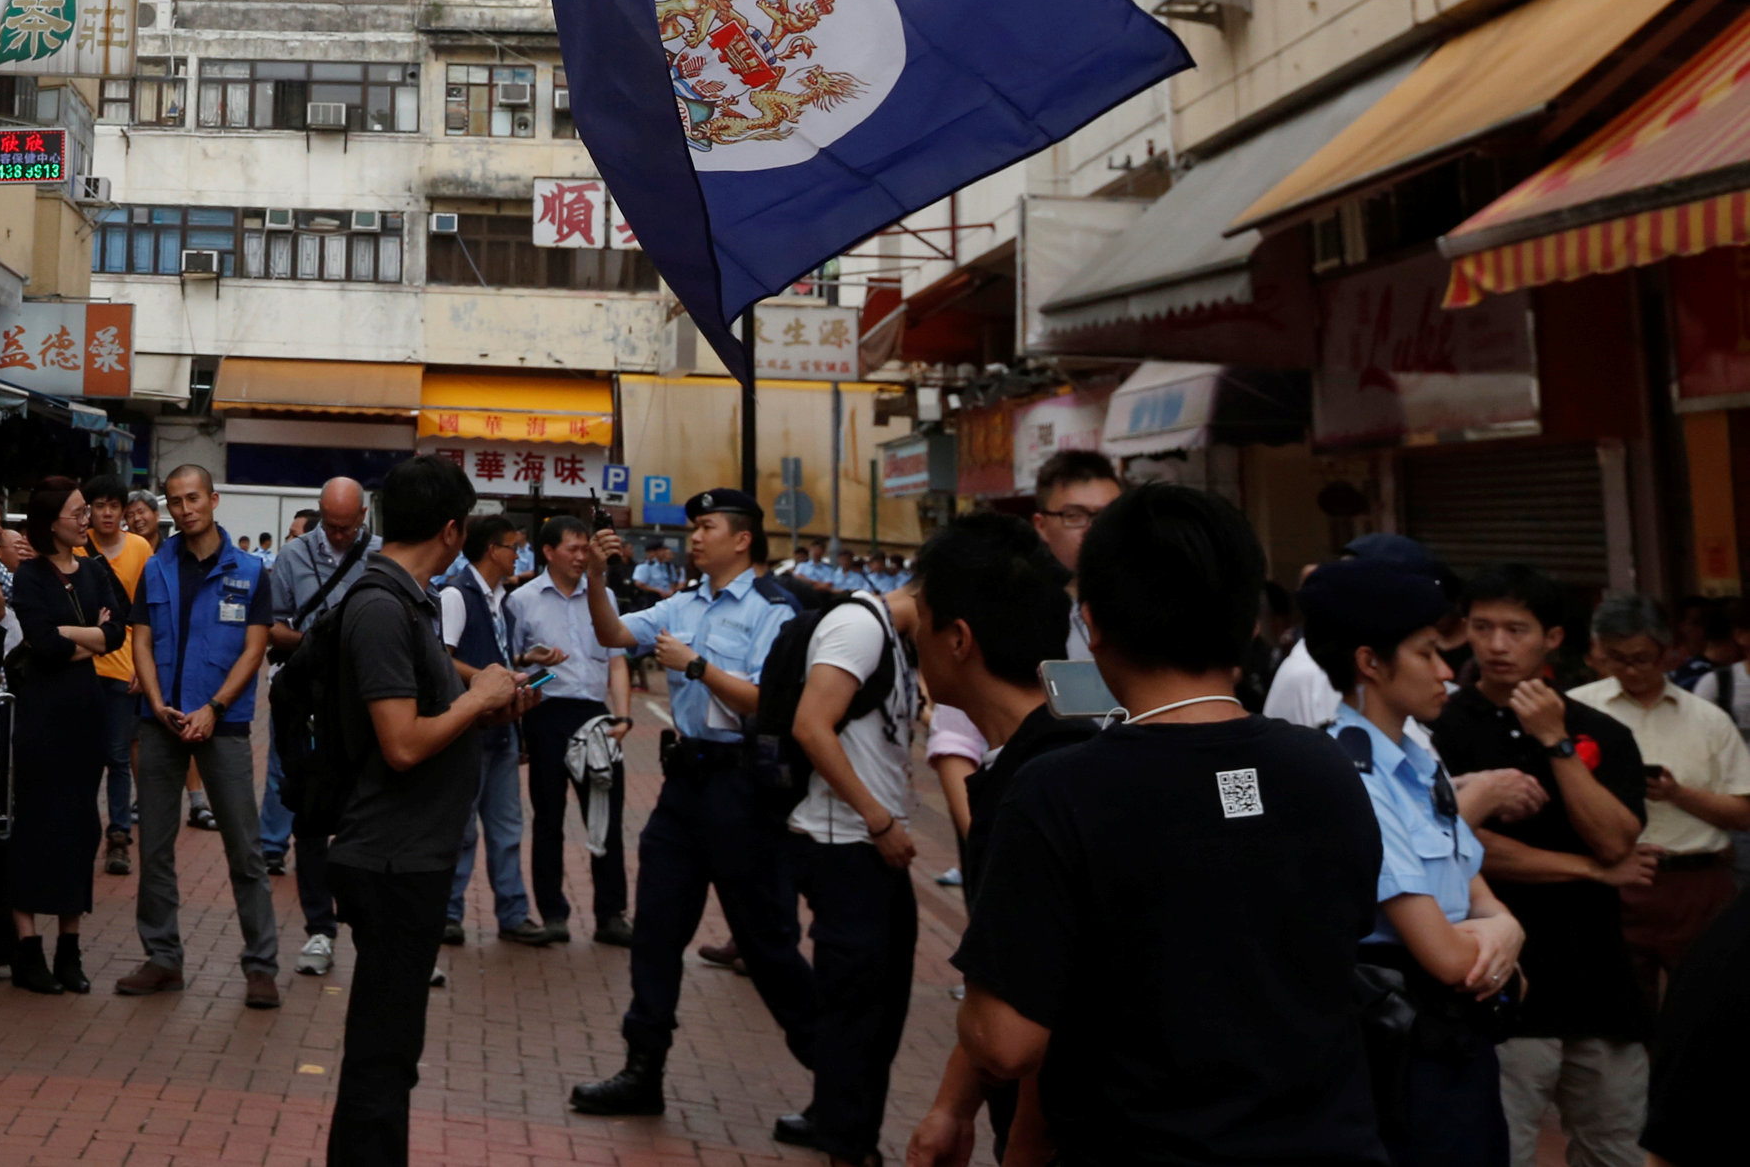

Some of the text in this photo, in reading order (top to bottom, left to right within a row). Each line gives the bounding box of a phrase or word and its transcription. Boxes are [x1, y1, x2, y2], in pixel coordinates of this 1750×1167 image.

[0, 133, 46, 153] 欣欣
[538, 182, 637, 245] 順
[438, 412, 591, 439] 國華海味
[607, 467, 626, 490] P
[648, 478, 668, 501] P
